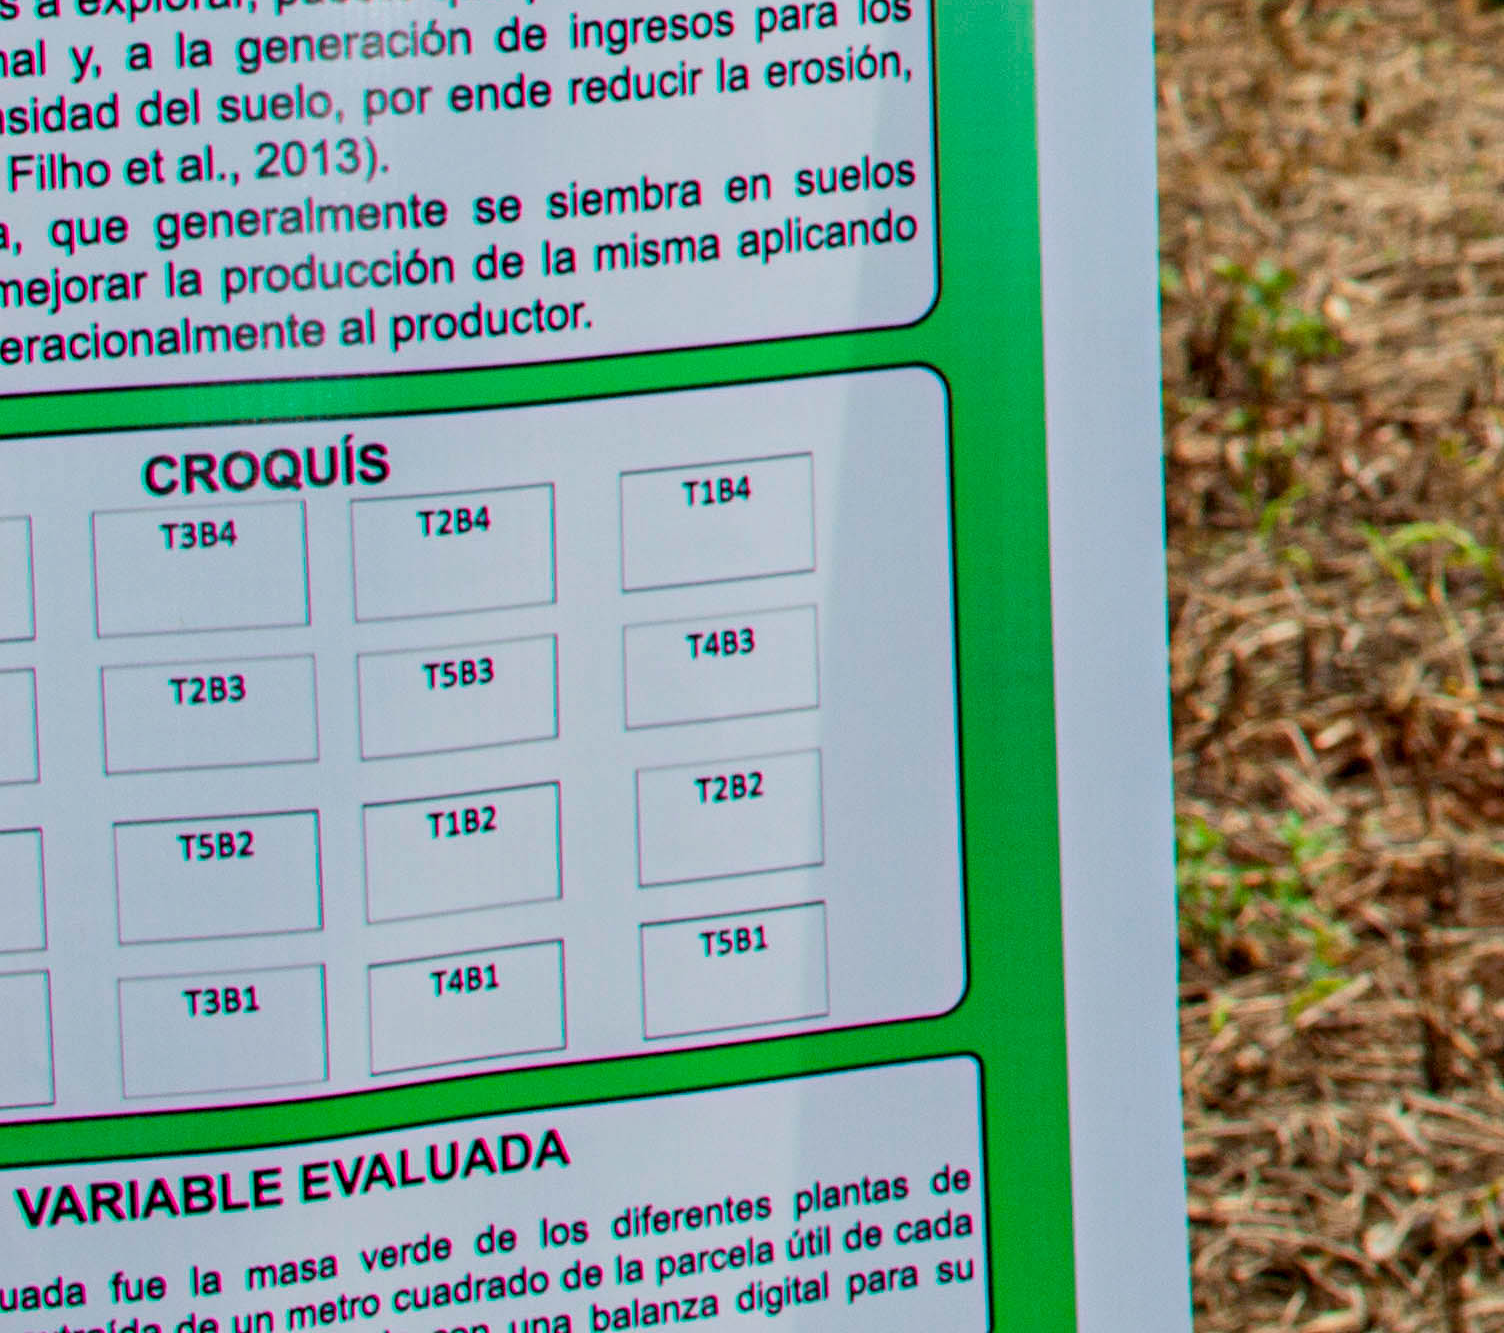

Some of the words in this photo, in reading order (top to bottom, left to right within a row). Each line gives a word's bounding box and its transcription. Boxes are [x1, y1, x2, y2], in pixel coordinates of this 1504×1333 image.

[68, 45, 102, 85] y,
[125, 43, 152, 72] a
[175, 31, 212, 69] la
[234, 20, 472, 75] generación
[494, 15, 547, 53] de
[569, 10, 735, 56] ingresos
[755, 1, 838, 45] para
[0, 92, 119, 136] sidad
[136, 87, 200, 129] del
[216, 84, 343, 125] suelo,
[362, 85, 432, 125] por
[446, 72, 552, 114] ende
[568, 61, 703, 106] reducir
[716, 58, 749, 93] la
[763, 45, 911, 89] erosión,
[7, 153, 111, 194] Filho
[122, 149, 165, 187] et
[176, 144, 239, 187] al.,
[254, 137, 388, 181] 2013).
[48, 215, 129, 257] que
[153, 193, 448, 252] generalmente
[472, 195, 522, 226] se
[546, 175, 702, 220] siembra
[724, 173, 771, 204] en
[794, 155, 915, 197] suelos
[164, 261, 202, 299] la
[220, 249, 454, 305] producción
[472, 244, 524, 282] de
[541, 239, 576, 277] la
[593, 232, 720, 272] misma
[736, 207, 917, 266] aplicando
[339, 308, 375, 347] al
[389, 299, 592, 353] productor.
[142, 435, 391, 497] CROQUÍS
[681, 475, 751, 508] T1B4
[158, 520, 237, 549] T3B4
[416, 506, 491, 538] T2B4
[684, 628, 755, 661] T4B3
[168, 675, 246, 706] T2B3
[421, 657, 494, 691] T5B3
[693, 771, 763, 805] T2B2
[425, 805, 496, 840] T1B2
[176, 831, 254, 861] T5B2
[698, 925, 768, 957] T5B1
[429, 963, 499, 997] T4B1
[181, 986, 260, 1018] T3B1
[12, 1168, 284, 1229] VARIABLE
[298, 1129, 571, 1205] EVALUADA
[108, 1271, 167, 1305] fue
[189, 1266, 222, 1298] la
[244, 1255, 338, 1292] masa
[358, 1233, 452, 1274] verde
[473, 1224, 517, 1258] de
[539, 1218, 589, 1250] los
[610, 1196, 772, 1240] diferentes
[793, 1176, 909, 1222] plantas
[929, 1164, 970, 1196] de
[285, 1293, 381, 1333] metro
[391, 1266, 549, 1315] cuadrado
[560, 1259, 603, 1293] de
[614, 1255, 644, 1285] la
[656, 1237, 774, 1288] parcela
[785, 1225, 831, 1261] útil
[842, 1221, 882, 1253] de
[893, 1210, 970, 1245] cada
[589, 1294, 719, 1333] balanza
[735, 1270, 829, 1317] digital
[845, 1265, 918, 1305] para
[936, 1261, 973, 1285] su
